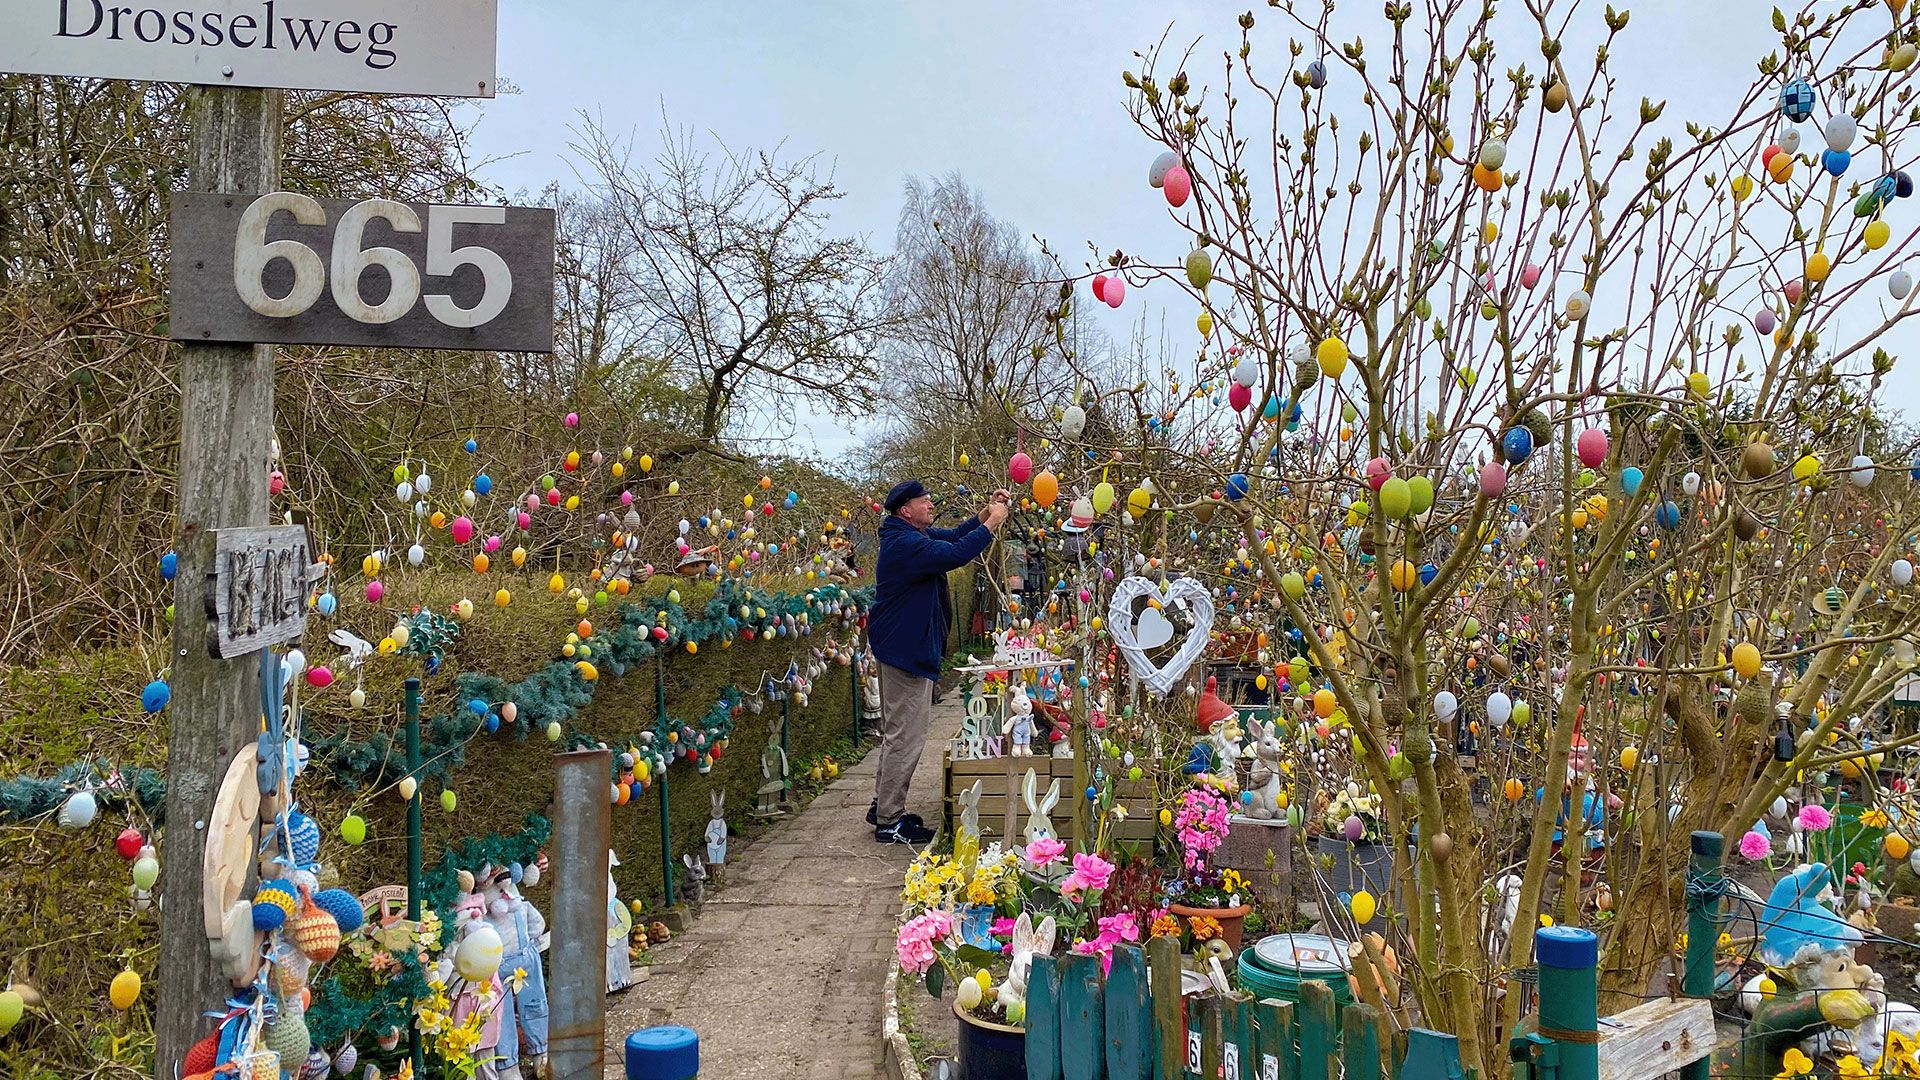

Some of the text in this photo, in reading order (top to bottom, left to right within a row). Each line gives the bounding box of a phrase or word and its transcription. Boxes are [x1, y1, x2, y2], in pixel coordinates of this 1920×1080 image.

[53, 0, 399, 69] Drosselweg
[233, 191, 513, 329] 665
[1189, 1039, 1198, 1068] 6
